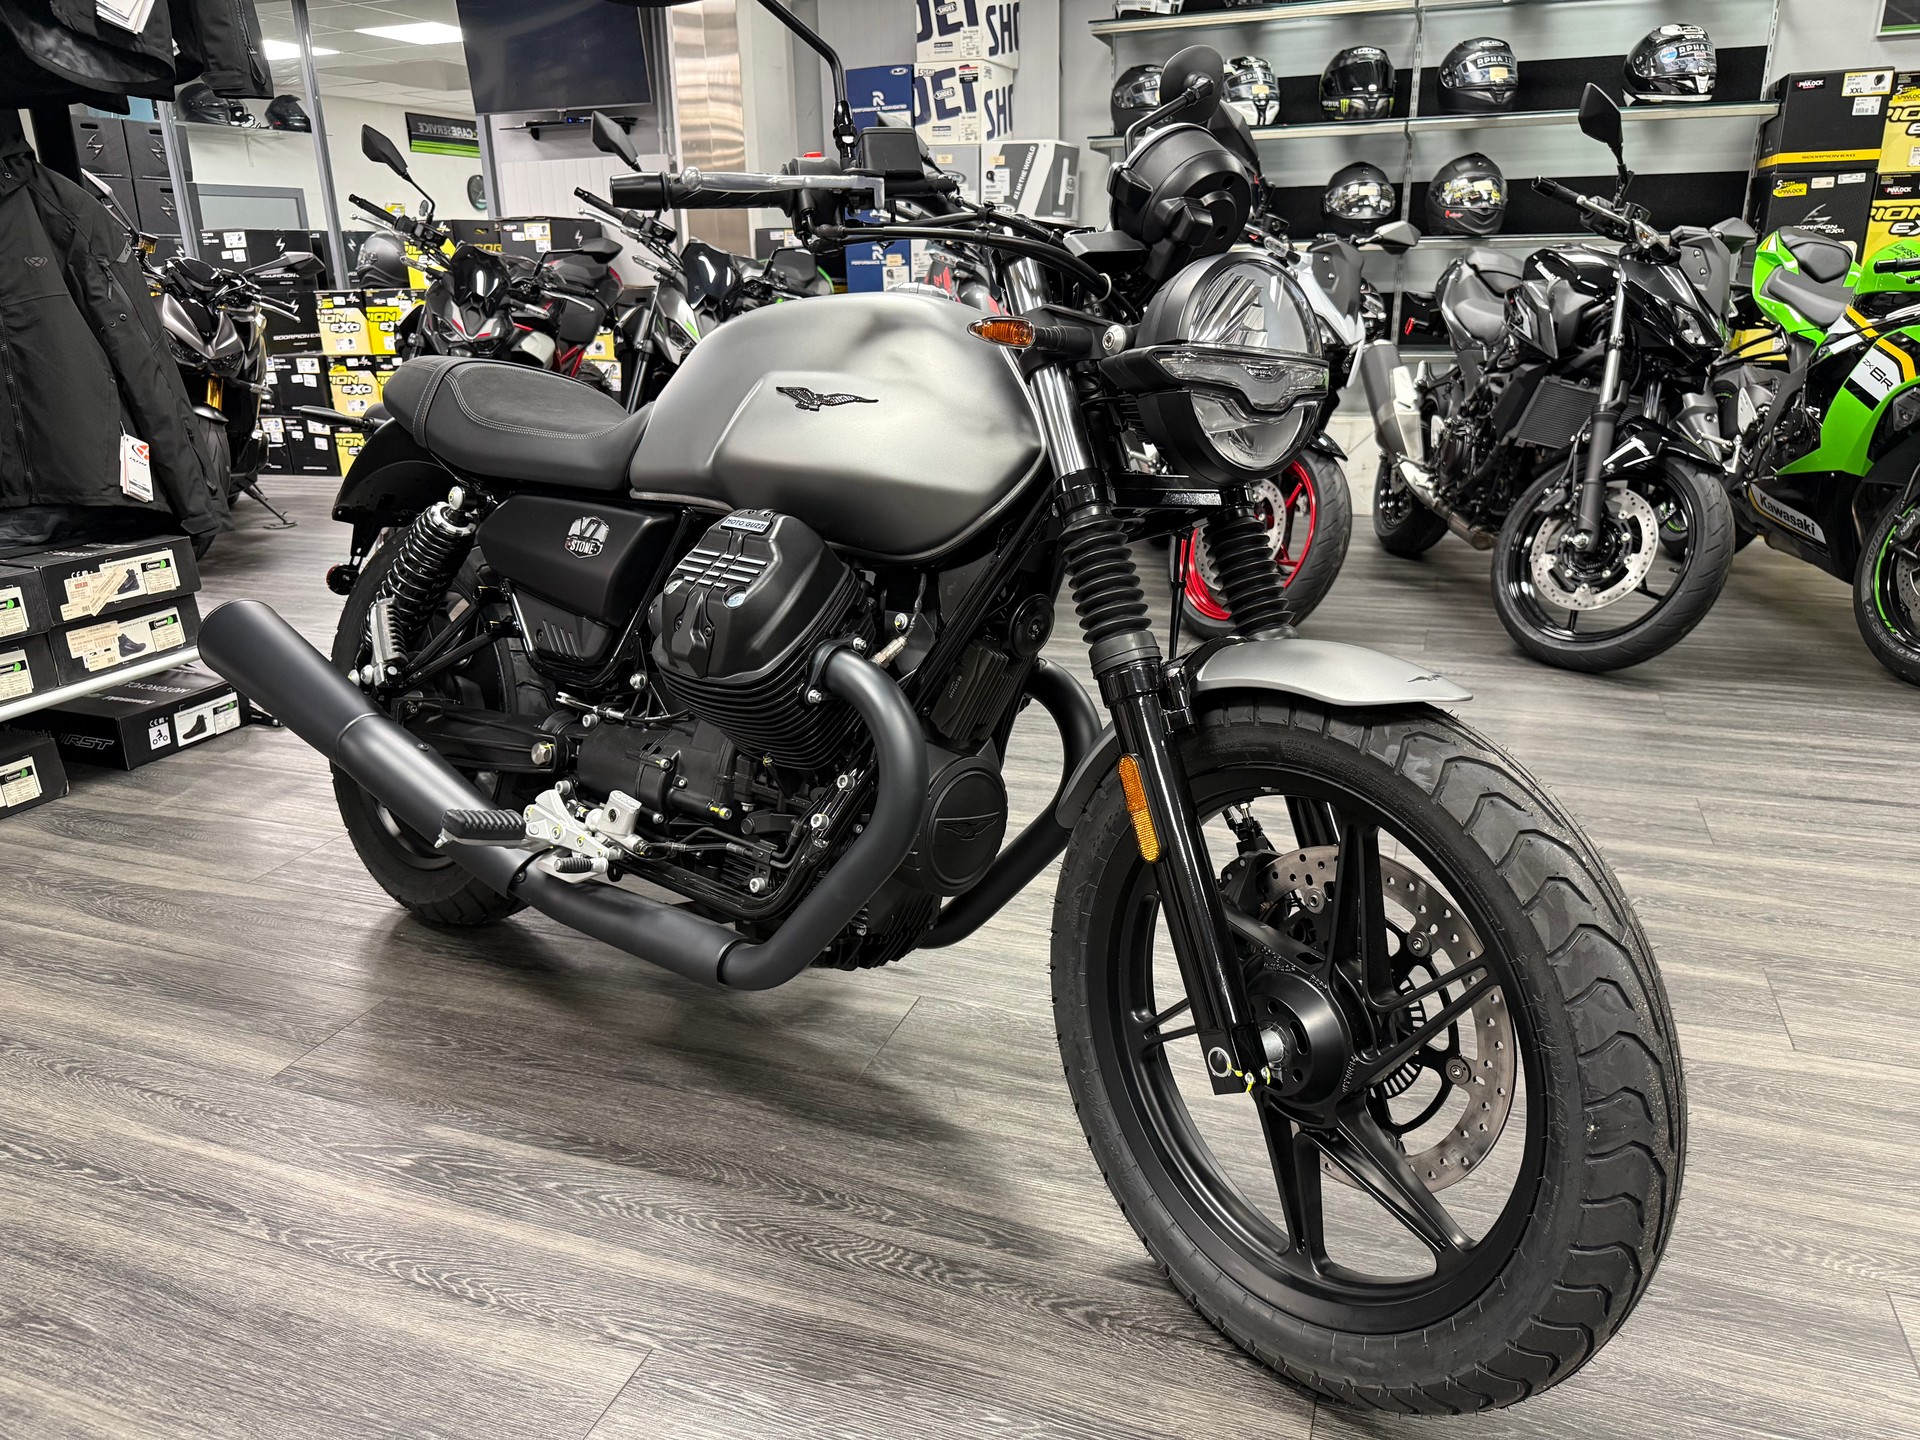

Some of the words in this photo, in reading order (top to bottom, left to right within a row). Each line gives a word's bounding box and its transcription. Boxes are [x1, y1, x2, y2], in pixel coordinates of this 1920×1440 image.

[1679, 44, 1705, 54] RPHA
[1476, 56, 1503, 65] RPHA
[1017, 169, 1027, 183] THE
[1022, 145, 1035, 170] WORLD
[331, 323, 360, 332] EXO
[342, 385, 372, 394] EXO
[1759, 493, 1816, 536] Kawasaki
[725, 518, 744, 527] MOTO
[745, 520, 766, 530] GUZZI
[570, 540, 596, 554] STONE
[64, 734, 115, 750] RST
